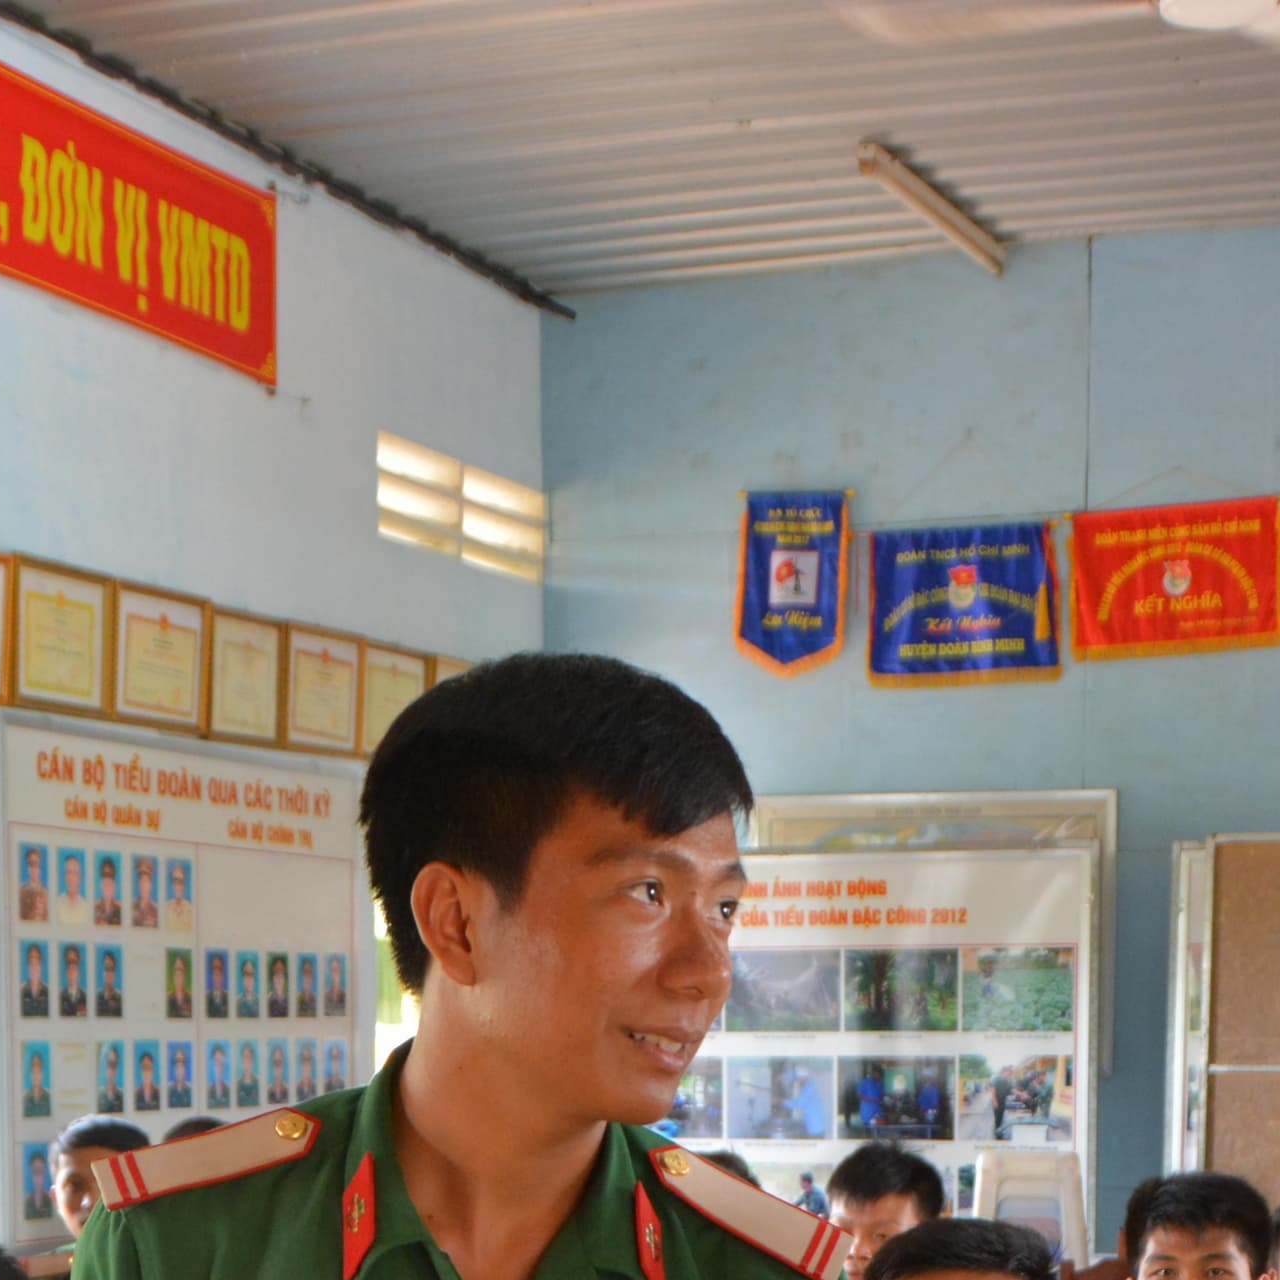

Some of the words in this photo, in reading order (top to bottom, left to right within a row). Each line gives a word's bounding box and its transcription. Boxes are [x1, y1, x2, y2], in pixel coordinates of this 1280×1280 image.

[20, 134, 105, 270] ĐƠN
[113, 178, 149, 312] VỊ
[158, 199, 252, 334] VMTD
[1134, 592, 1164, 616] KẾT
[36, 747, 75, 784] CÁN
[82, 754, 106, 791] BỘ
[112, 753, 151, 794] TIỂU
[157, 766, 202, 801] ĐOÀN
[208, 777, 239, 807] QUA
[243, 778, 273, 811] CÁC
[806, 879, 843, 900] HOẠT
[847, 877, 888, 899] ĐỘNG
[740, 904, 769, 927] CỦA
[773, 902, 804, 927] TIỂU
[808, 904, 849, 927] ĐOÀN
[852, 903, 882, 930] ĐẶC
[886, 903, 928, 926] CÔNG
[930, 907, 969, 925] 2012
